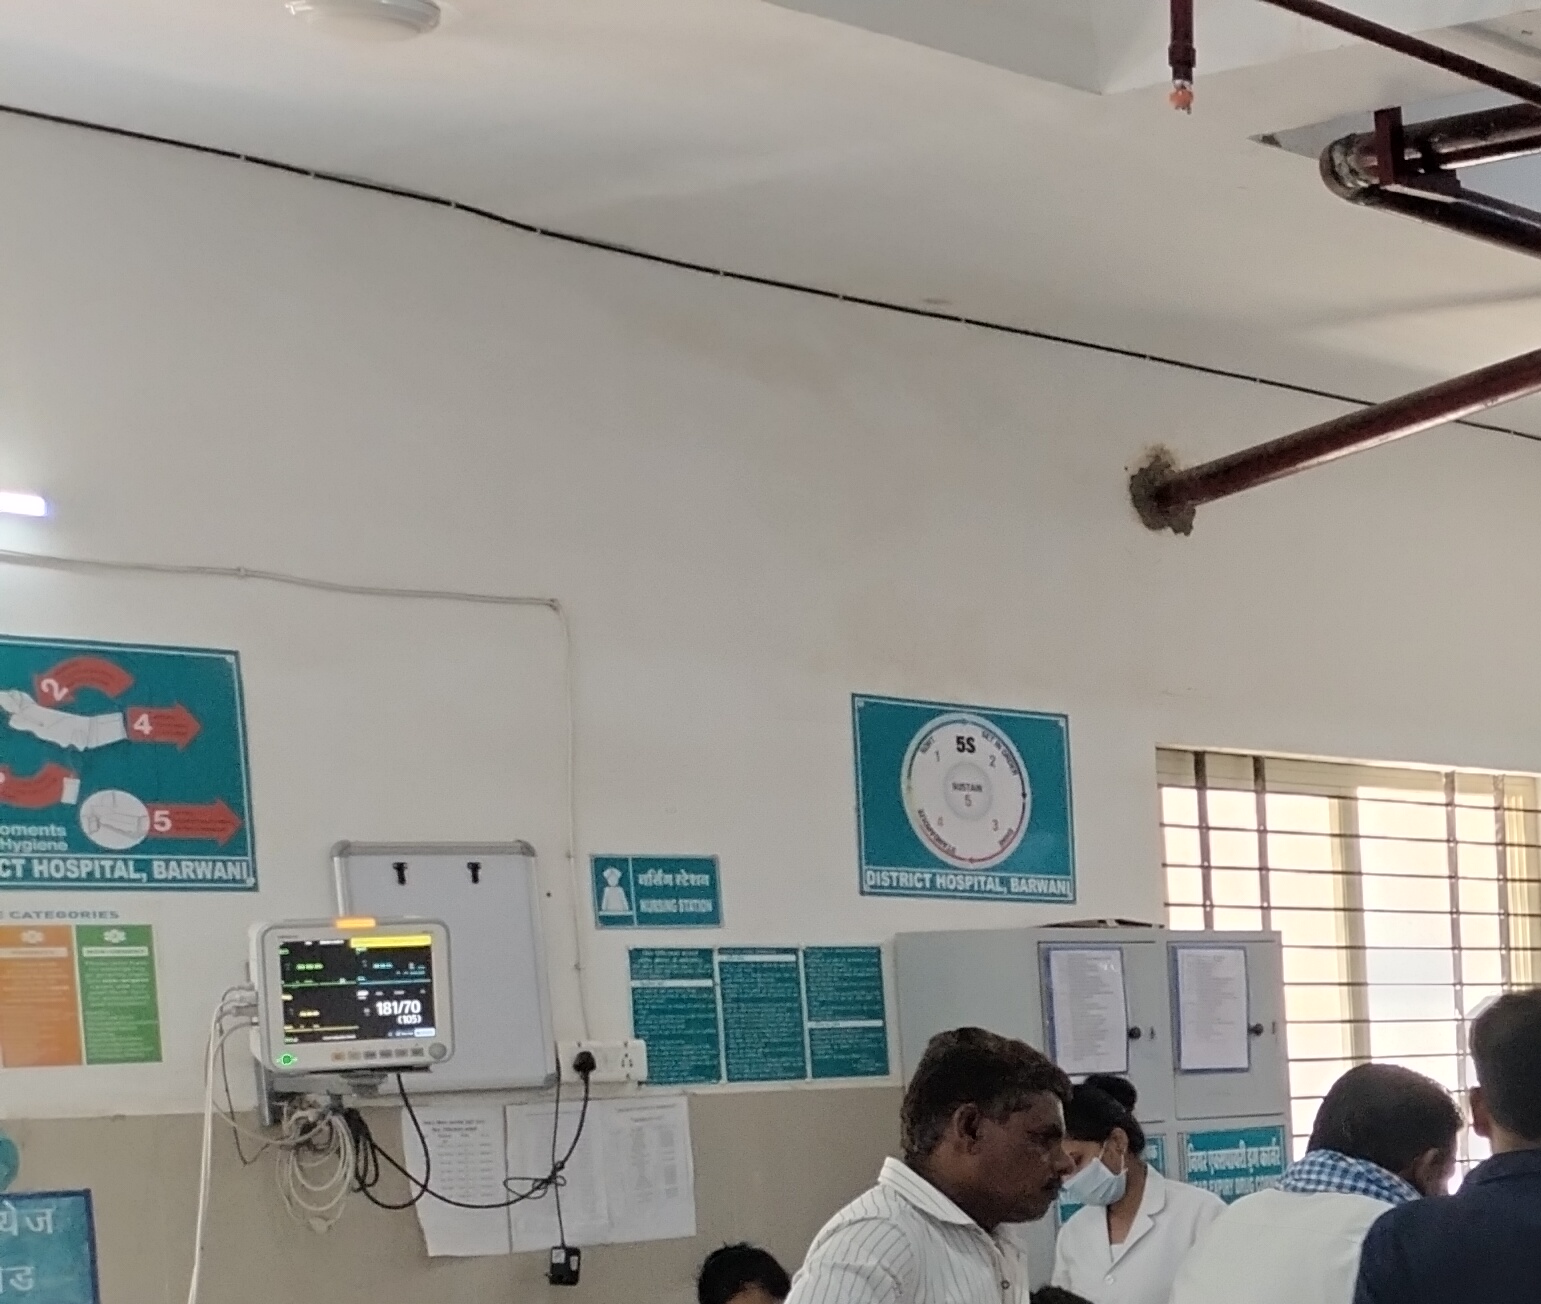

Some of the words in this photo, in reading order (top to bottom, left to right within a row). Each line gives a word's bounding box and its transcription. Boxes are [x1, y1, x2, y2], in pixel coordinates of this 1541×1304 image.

[40, 678, 69, 701] 2
[133, 714, 153, 735] 4
[956, 736, 976, 753] 5S
[934, 751, 940, 762] 1
[989, 755, 996, 768] 2
[951, 782, 983, 793] SUSTAIN
[965, 795, 972, 807] 5
[153, 810, 172, 832] 5
[992, 819, 999, 831] 3
[0, 838, 68, 853] Hygiene
[32, 859, 147, 882] HOSPITAL,
[153, 861, 247, 880] BARWANI
[866, 870, 932, 887] DISTRICT
[936, 875, 1008, 894] HOSPITAL,
[1010, 878, 1070, 894] BARWANI
[9, 910, 120, 919] CATEGORIES
[376, 1000, 421, 1016] 181/70
